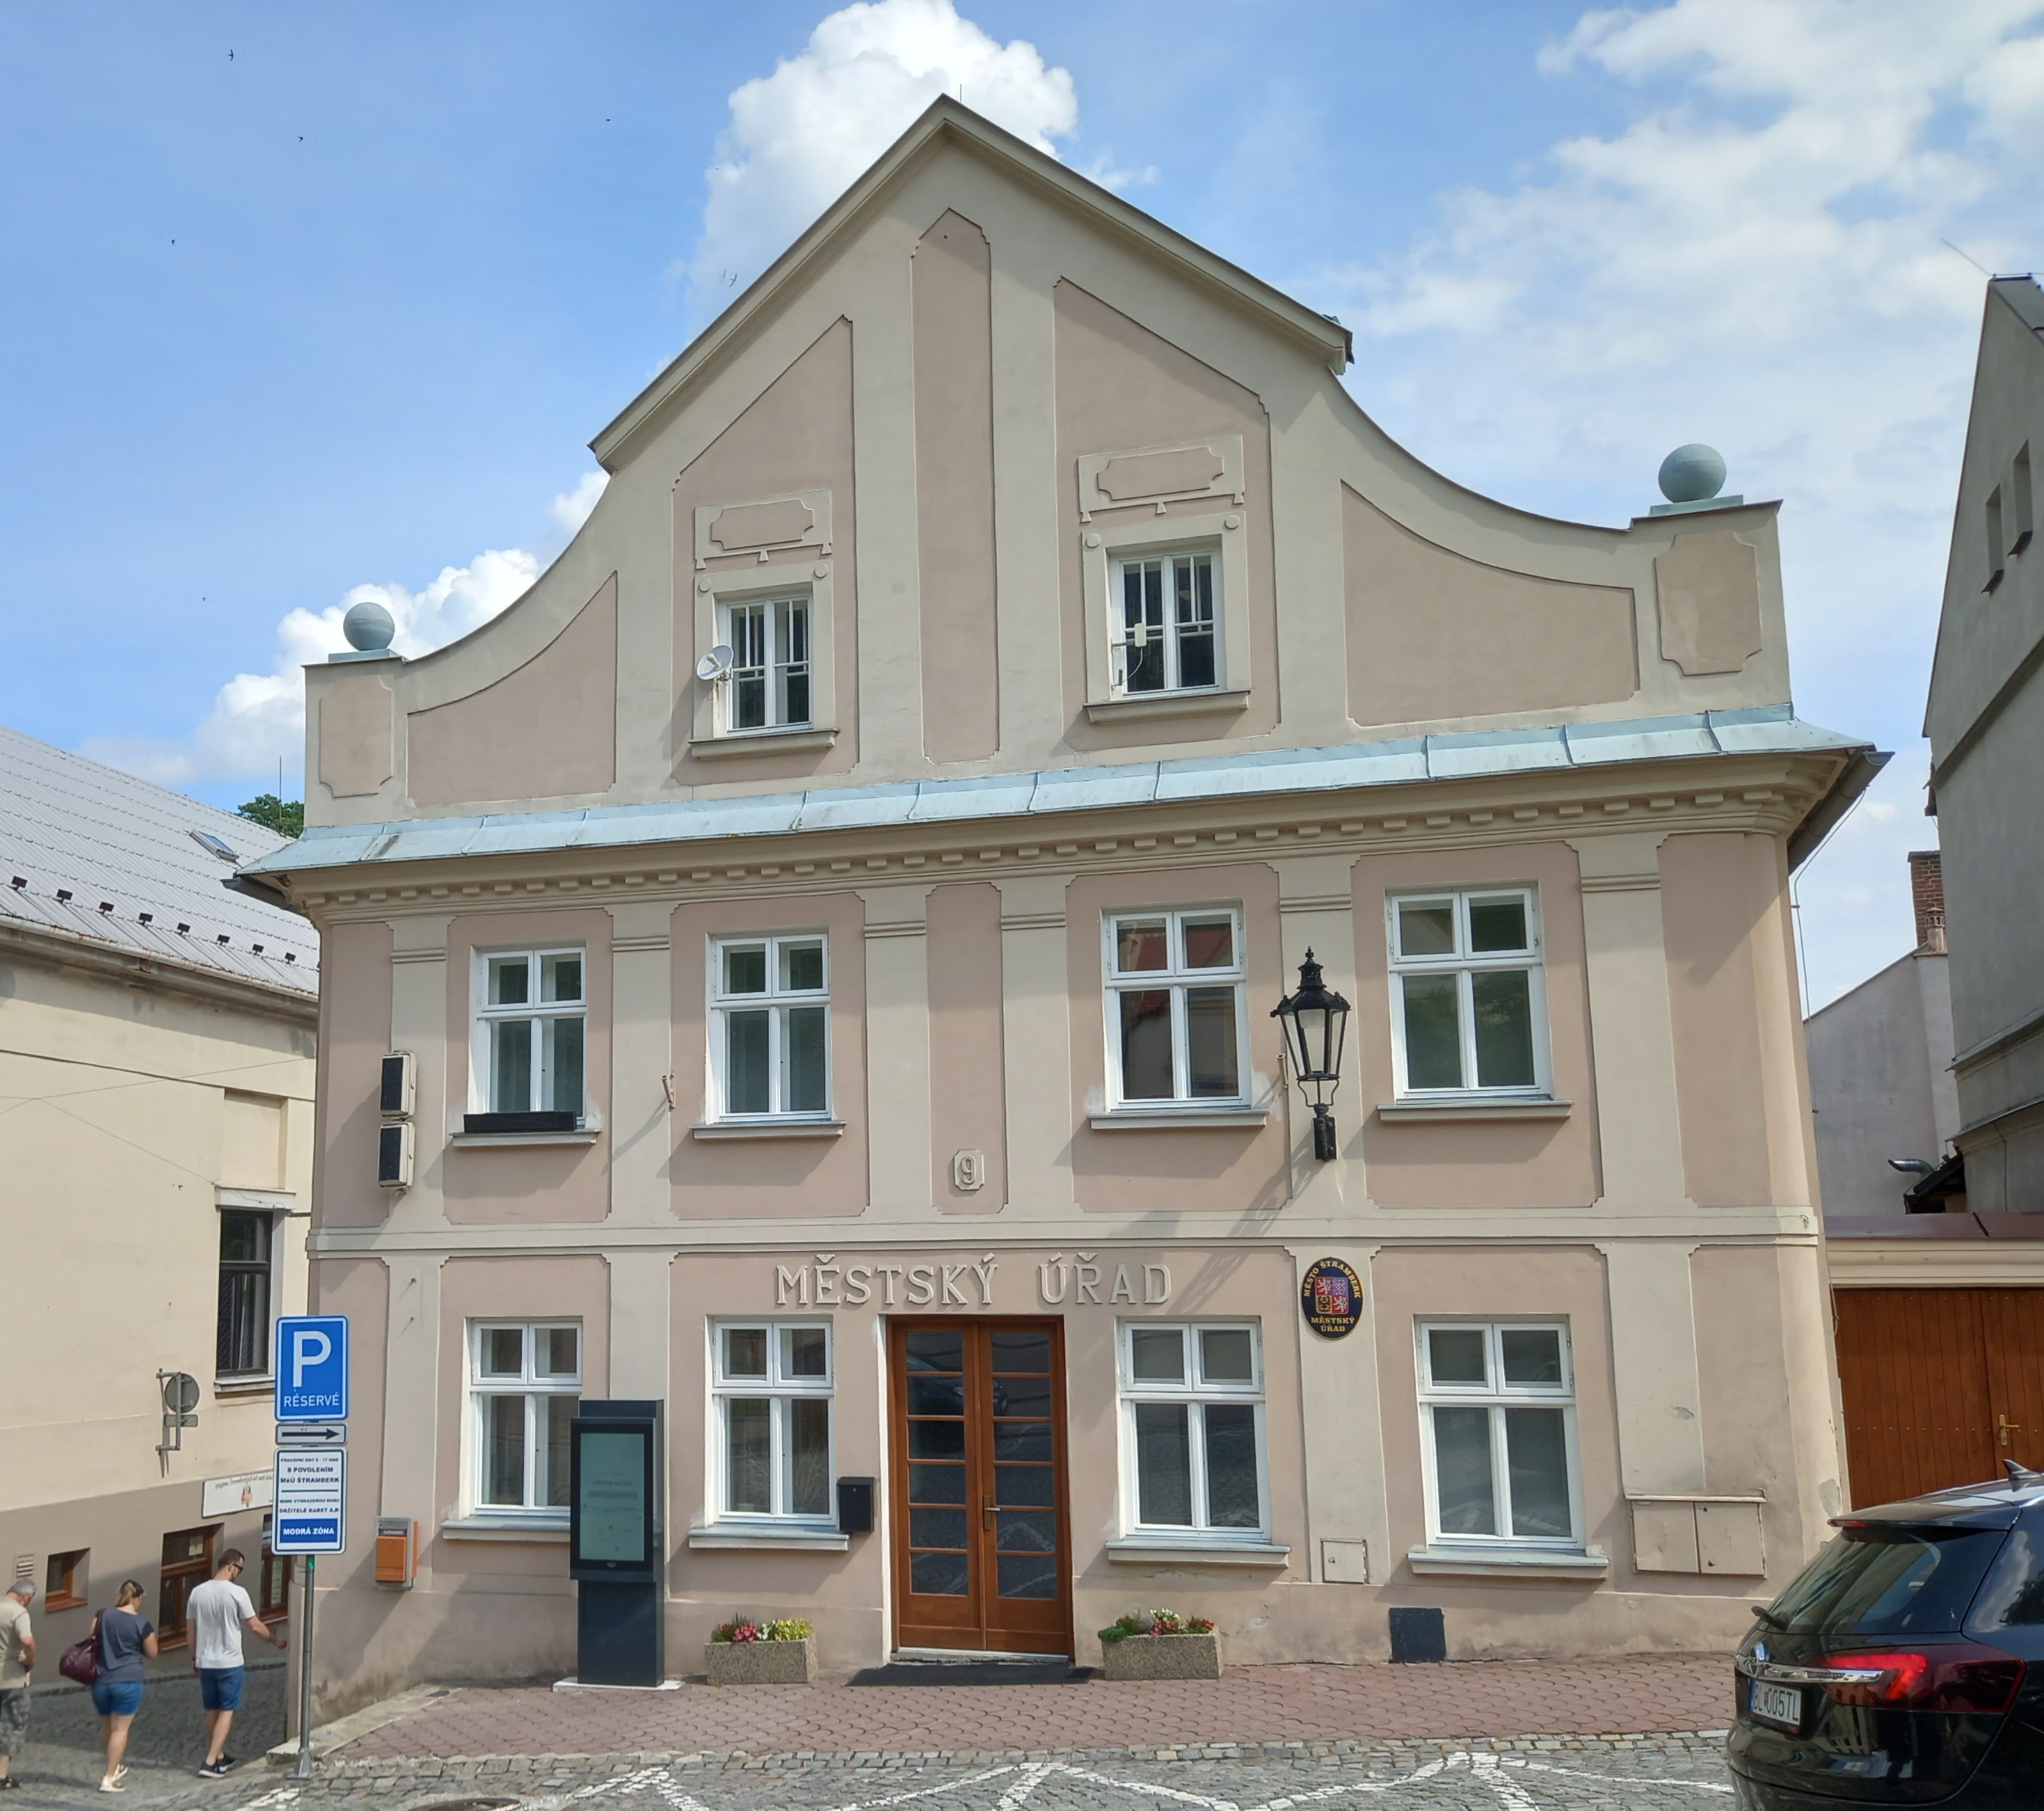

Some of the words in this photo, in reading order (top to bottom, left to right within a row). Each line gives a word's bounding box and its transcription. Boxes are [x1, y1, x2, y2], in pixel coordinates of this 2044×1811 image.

[960, 1155, 977, 1186] 9
[776, 1252, 998, 1305] MĚSTSKÝ
[1039, 1252, 1172, 1305] ÚŘAD
[1303, 1267, 1319, 1298] MĚSTO
[1320, 1260, 1362, 1299] ŠTRAMBERK
[1311, 1315, 1355, 1324] MĚSTSKÝ
[292, 1330, 332, 1388] P
[283, 1391, 340, 1408] RÉSERVÉ
[282, 1526, 312, 1535] MODRÁ
[312, 1526, 335, 1535] ZÓNA
